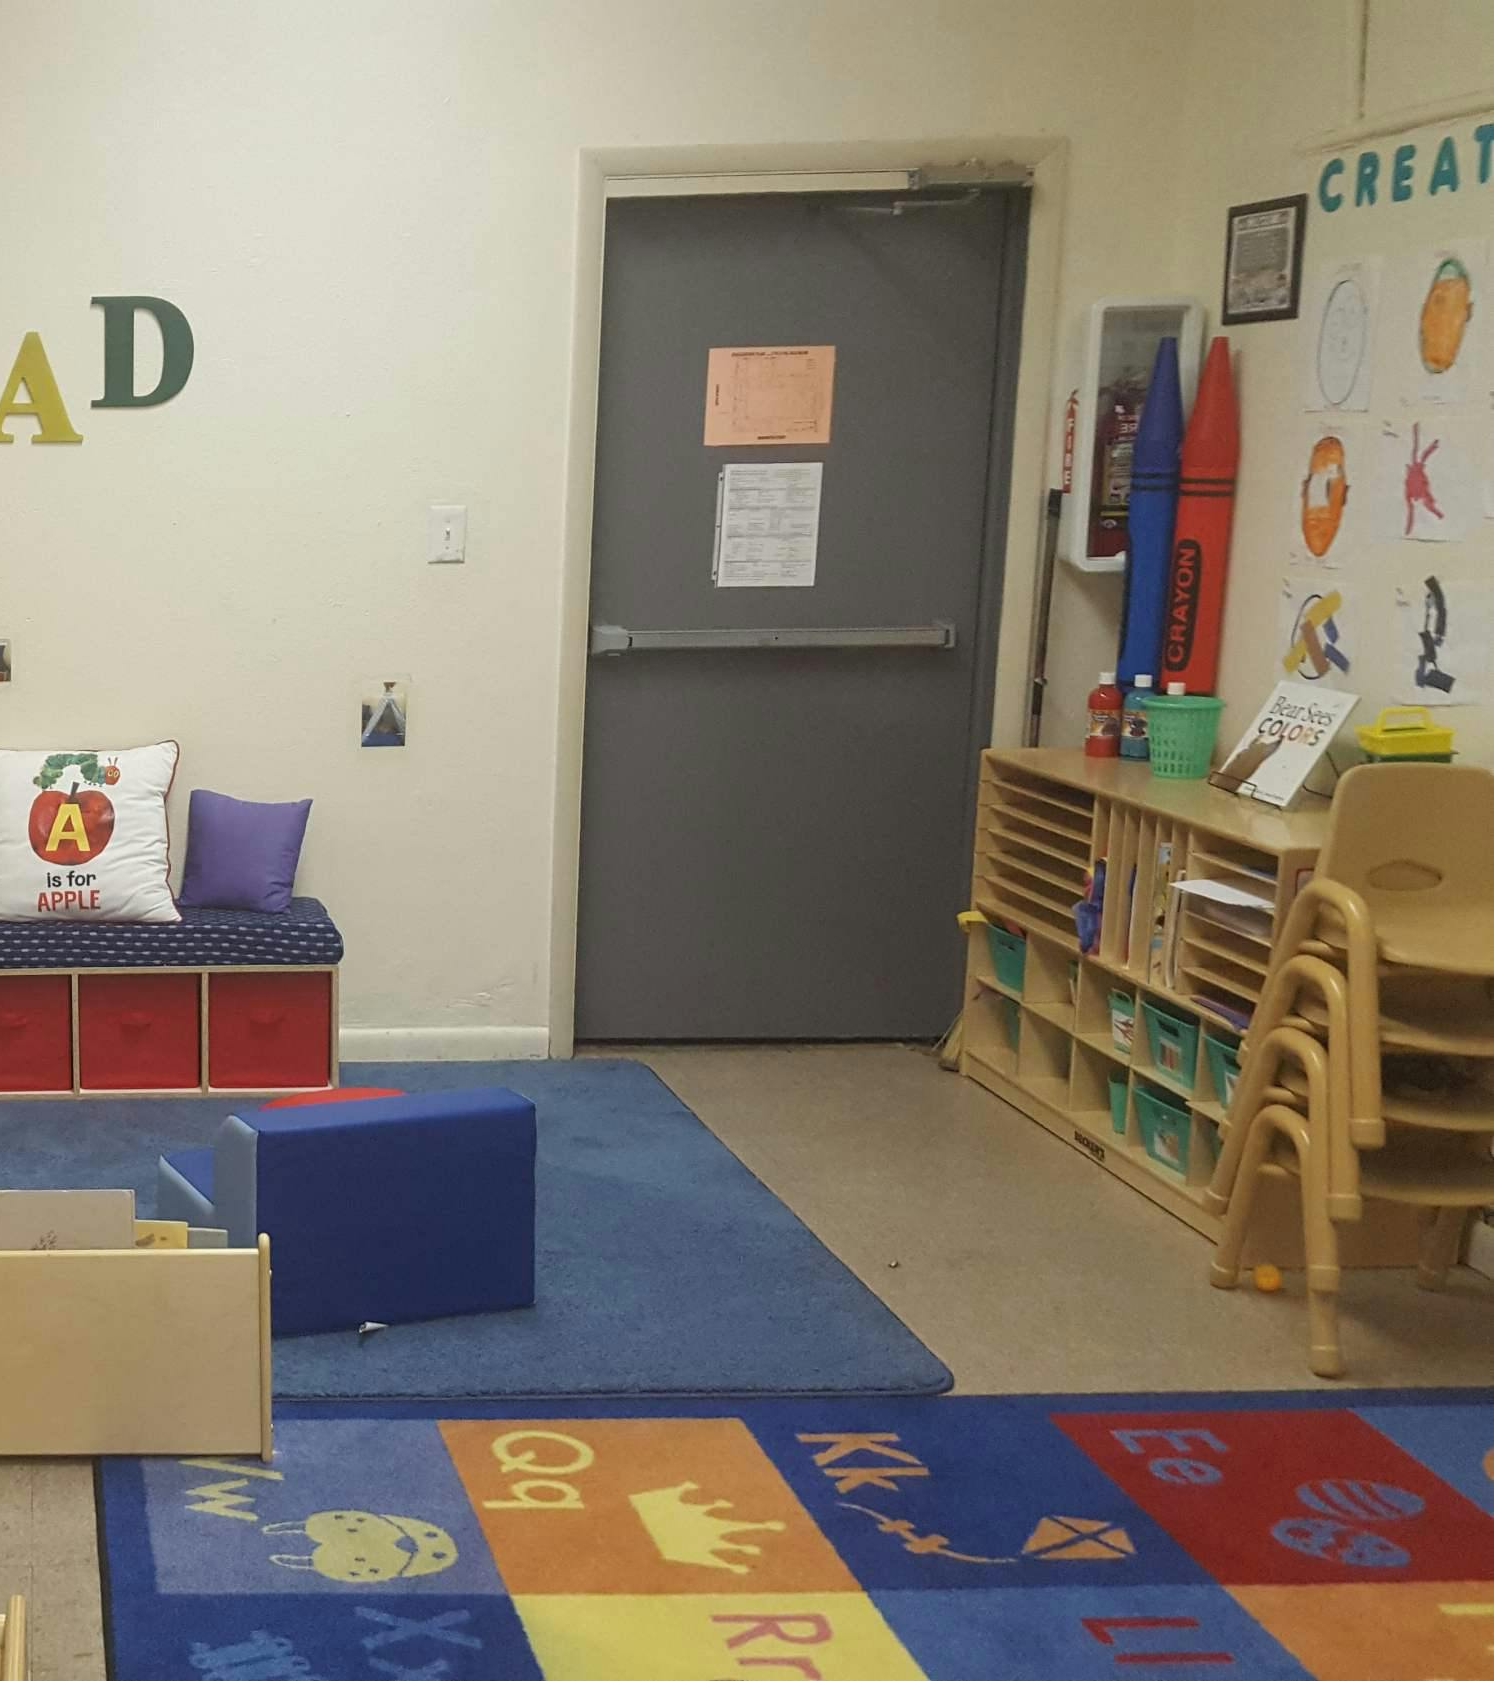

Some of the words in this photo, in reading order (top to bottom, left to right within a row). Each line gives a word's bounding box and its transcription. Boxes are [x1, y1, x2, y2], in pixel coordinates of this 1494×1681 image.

[1319, 124, 1494, 212] CREAT
[1167, 548, 1196, 663] CRAYON
[1269, 696, 1305, 719] Bear
[45, 804, 91, 851] A
[37, 890, 101, 912] APPLE
[47, 872, 62, 888] is
[66, 870, 97, 887] for
[482, 1430, 594, 1510] Qq
[796, 1433, 930, 1494] Kk
[1110, 1428, 1229, 1486] Ee
[178, 1459, 284, 1521] w
[711, 1614, 833, 1681] Rr
